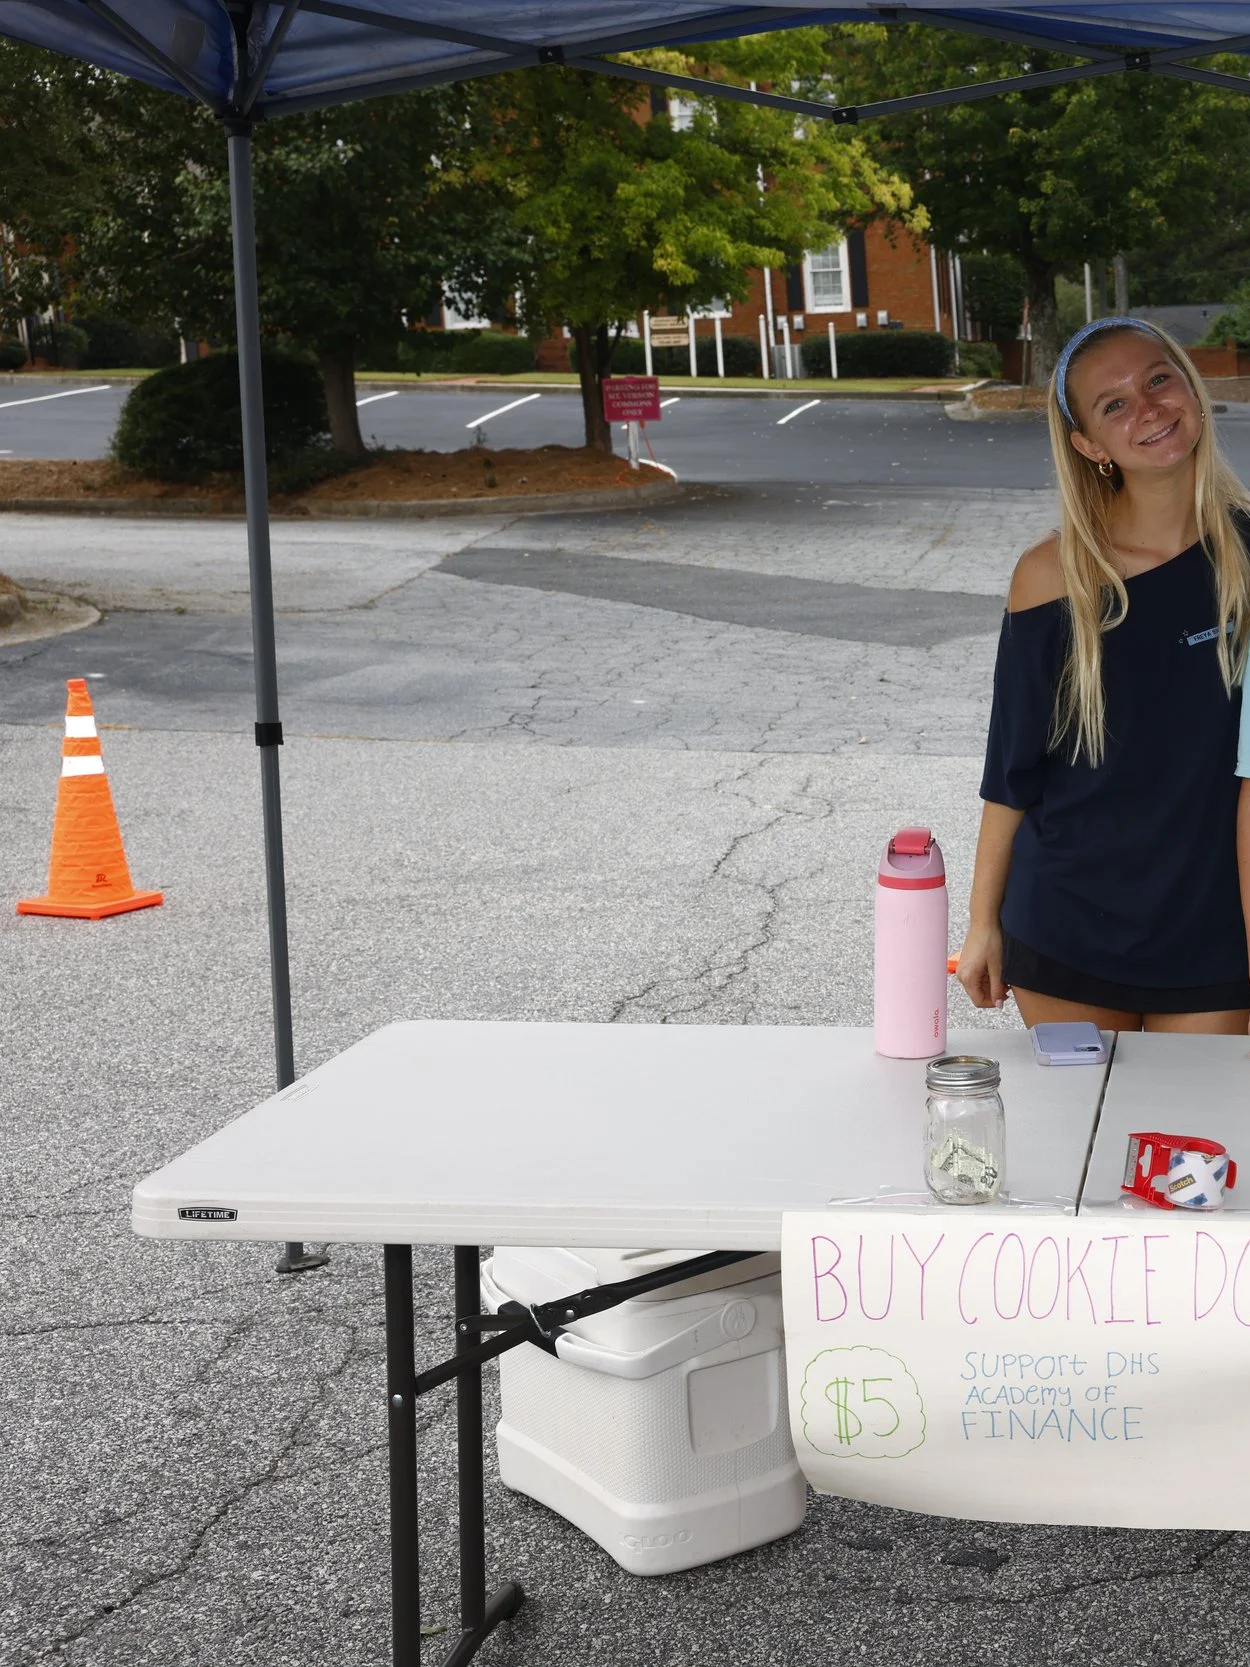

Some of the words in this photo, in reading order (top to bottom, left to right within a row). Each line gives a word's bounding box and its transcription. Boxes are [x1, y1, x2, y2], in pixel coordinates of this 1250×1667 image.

[1169, 1176, 1195, 1192] Scotch
[185, 1210, 230, 1219] LIFETIME
[812, 1232, 945, 1322] BUY
[958, 1232, 1171, 1325] COOKIE
[1107, 1351, 1161, 1379] DHS
[1085, 1384, 1118, 1404] OF
[825, 1376, 900, 1446] $5
[961, 1406, 1144, 1442] FINANCE
